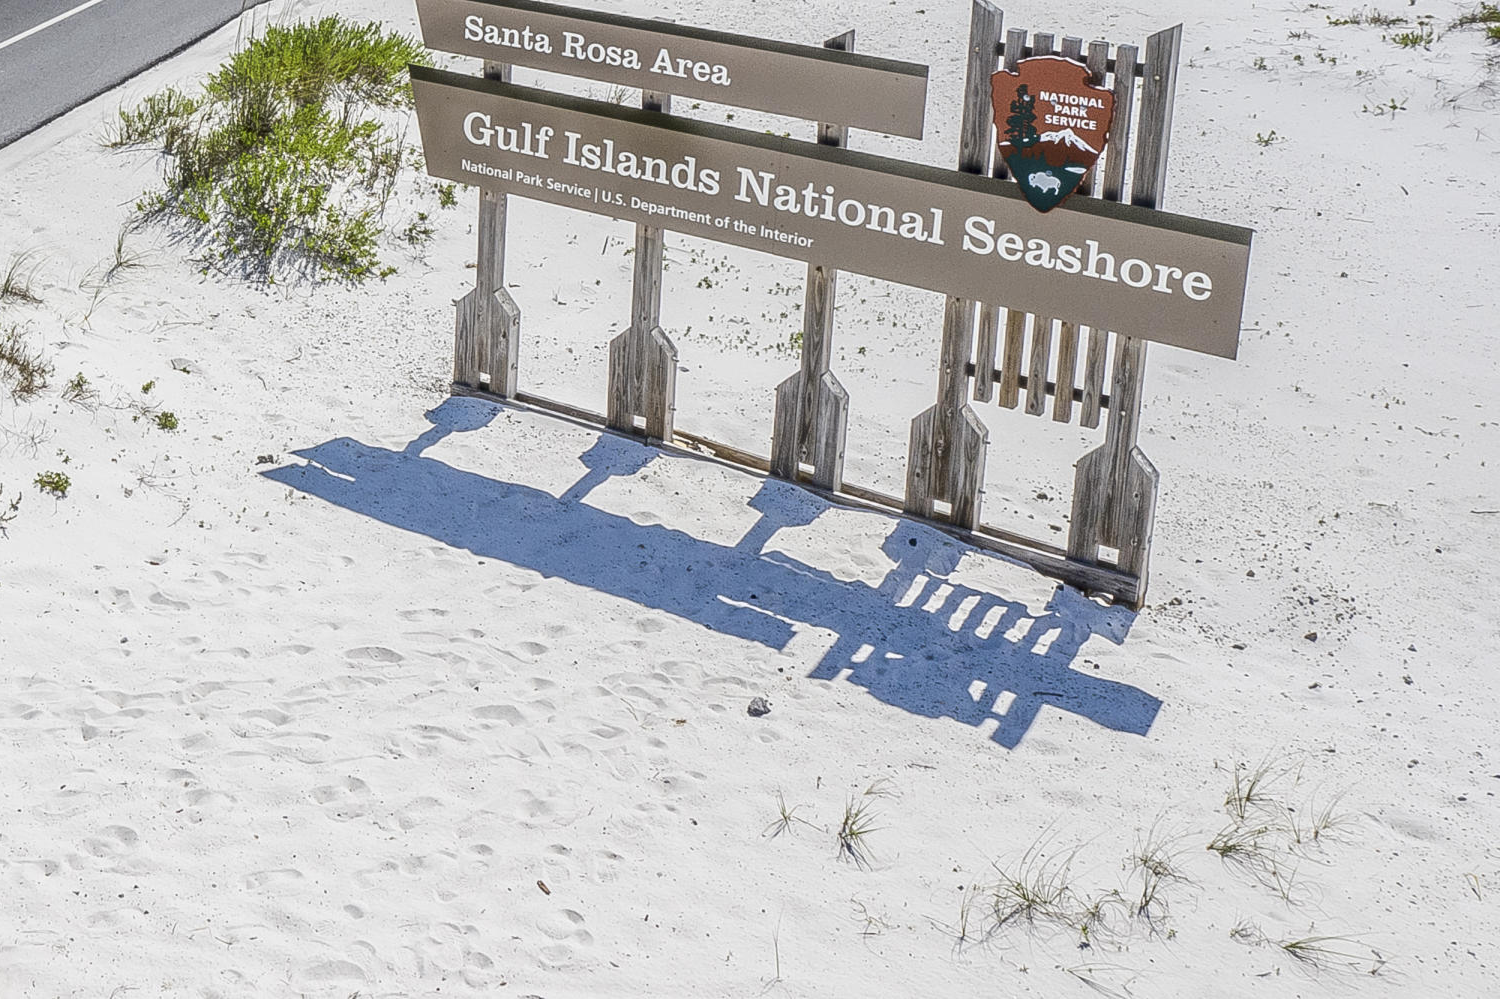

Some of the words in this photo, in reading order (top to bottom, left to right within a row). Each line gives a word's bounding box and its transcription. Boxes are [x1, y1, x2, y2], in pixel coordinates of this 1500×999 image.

[464, 15, 553, 55] Santa
[561, 31, 641, 70] Rosa
[650, 49, 731, 86] Area
[1039, 91, 1105, 109] NATIONAL
[1054, 104, 1088, 118] PARK
[1045, 115, 1097, 130] SERVICE
[461, 159, 513, 181] National
[516, 170, 543, 187] Park
[546, 178, 592, 198] Service
[601, 190, 627, 206] U.S.
[630, 196, 712, 226] Department
[714, 216, 731, 229] of
[732, 220, 757, 235] the
[760, 225, 814, 248] Interior
[463, 111, 554, 159] Gulf
[563, 131, 721, 195] Islands
[734, 167, 945, 245] National
[962, 216, 1213, 301] Seashore
